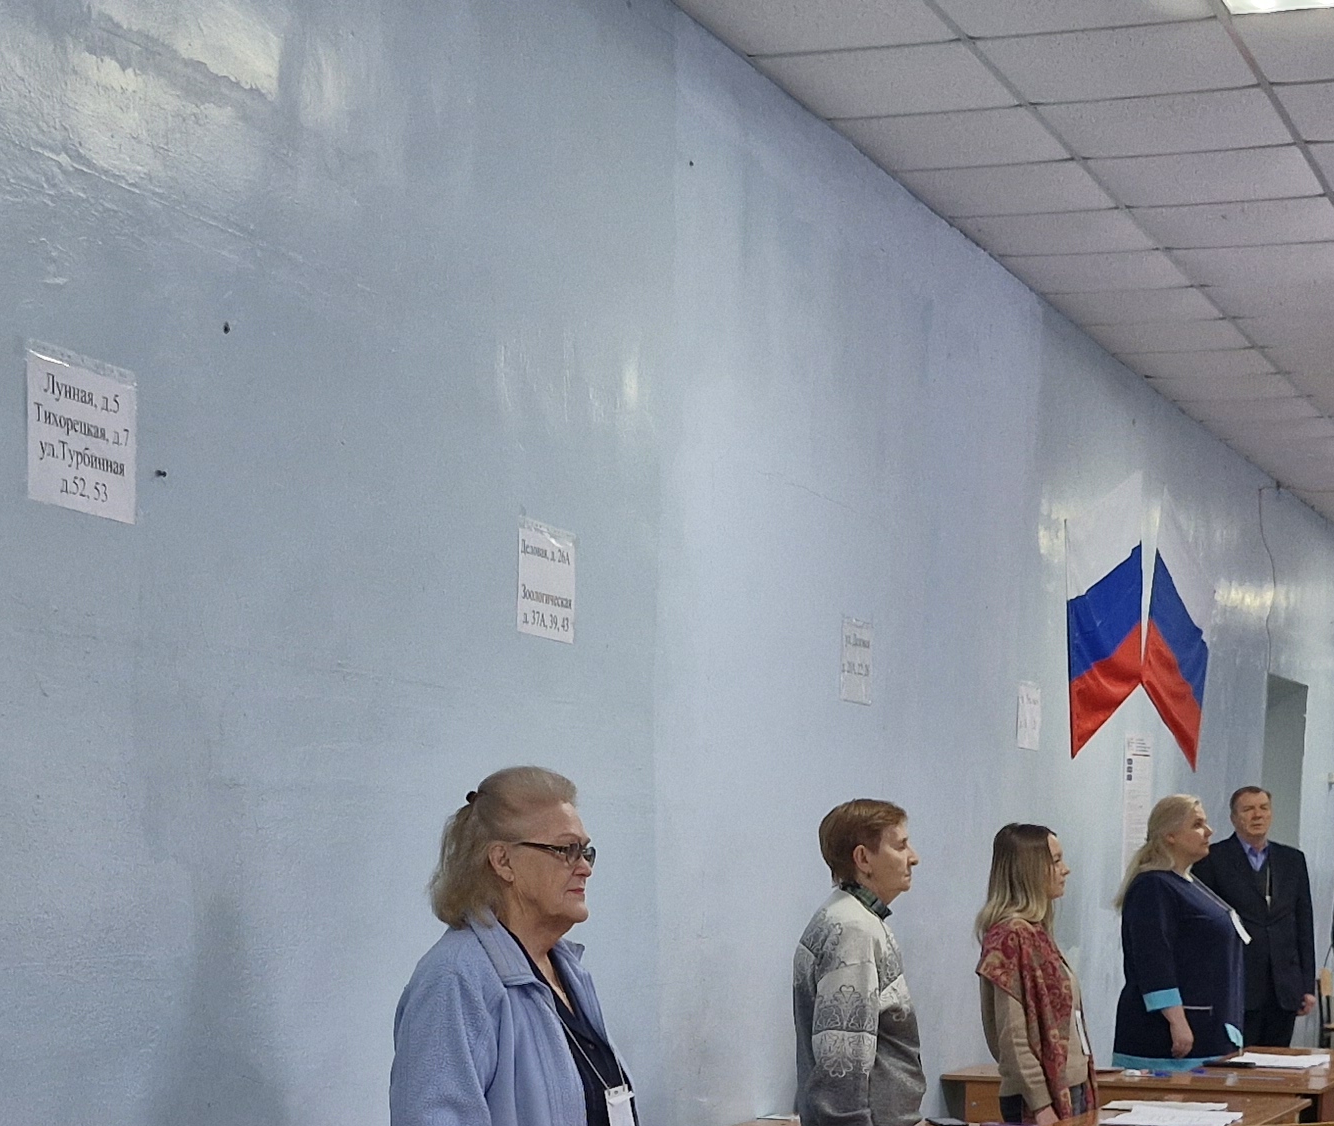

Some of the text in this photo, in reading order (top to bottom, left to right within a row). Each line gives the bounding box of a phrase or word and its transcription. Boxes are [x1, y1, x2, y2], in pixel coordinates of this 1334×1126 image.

[101, 394, 120, 414] д.5
[112, 429, 129, 447] д.7
[39, 439, 125, 477] ул.Турбинная
[93, 481, 108, 503] 53
[561, 616, 570, 633] 43
